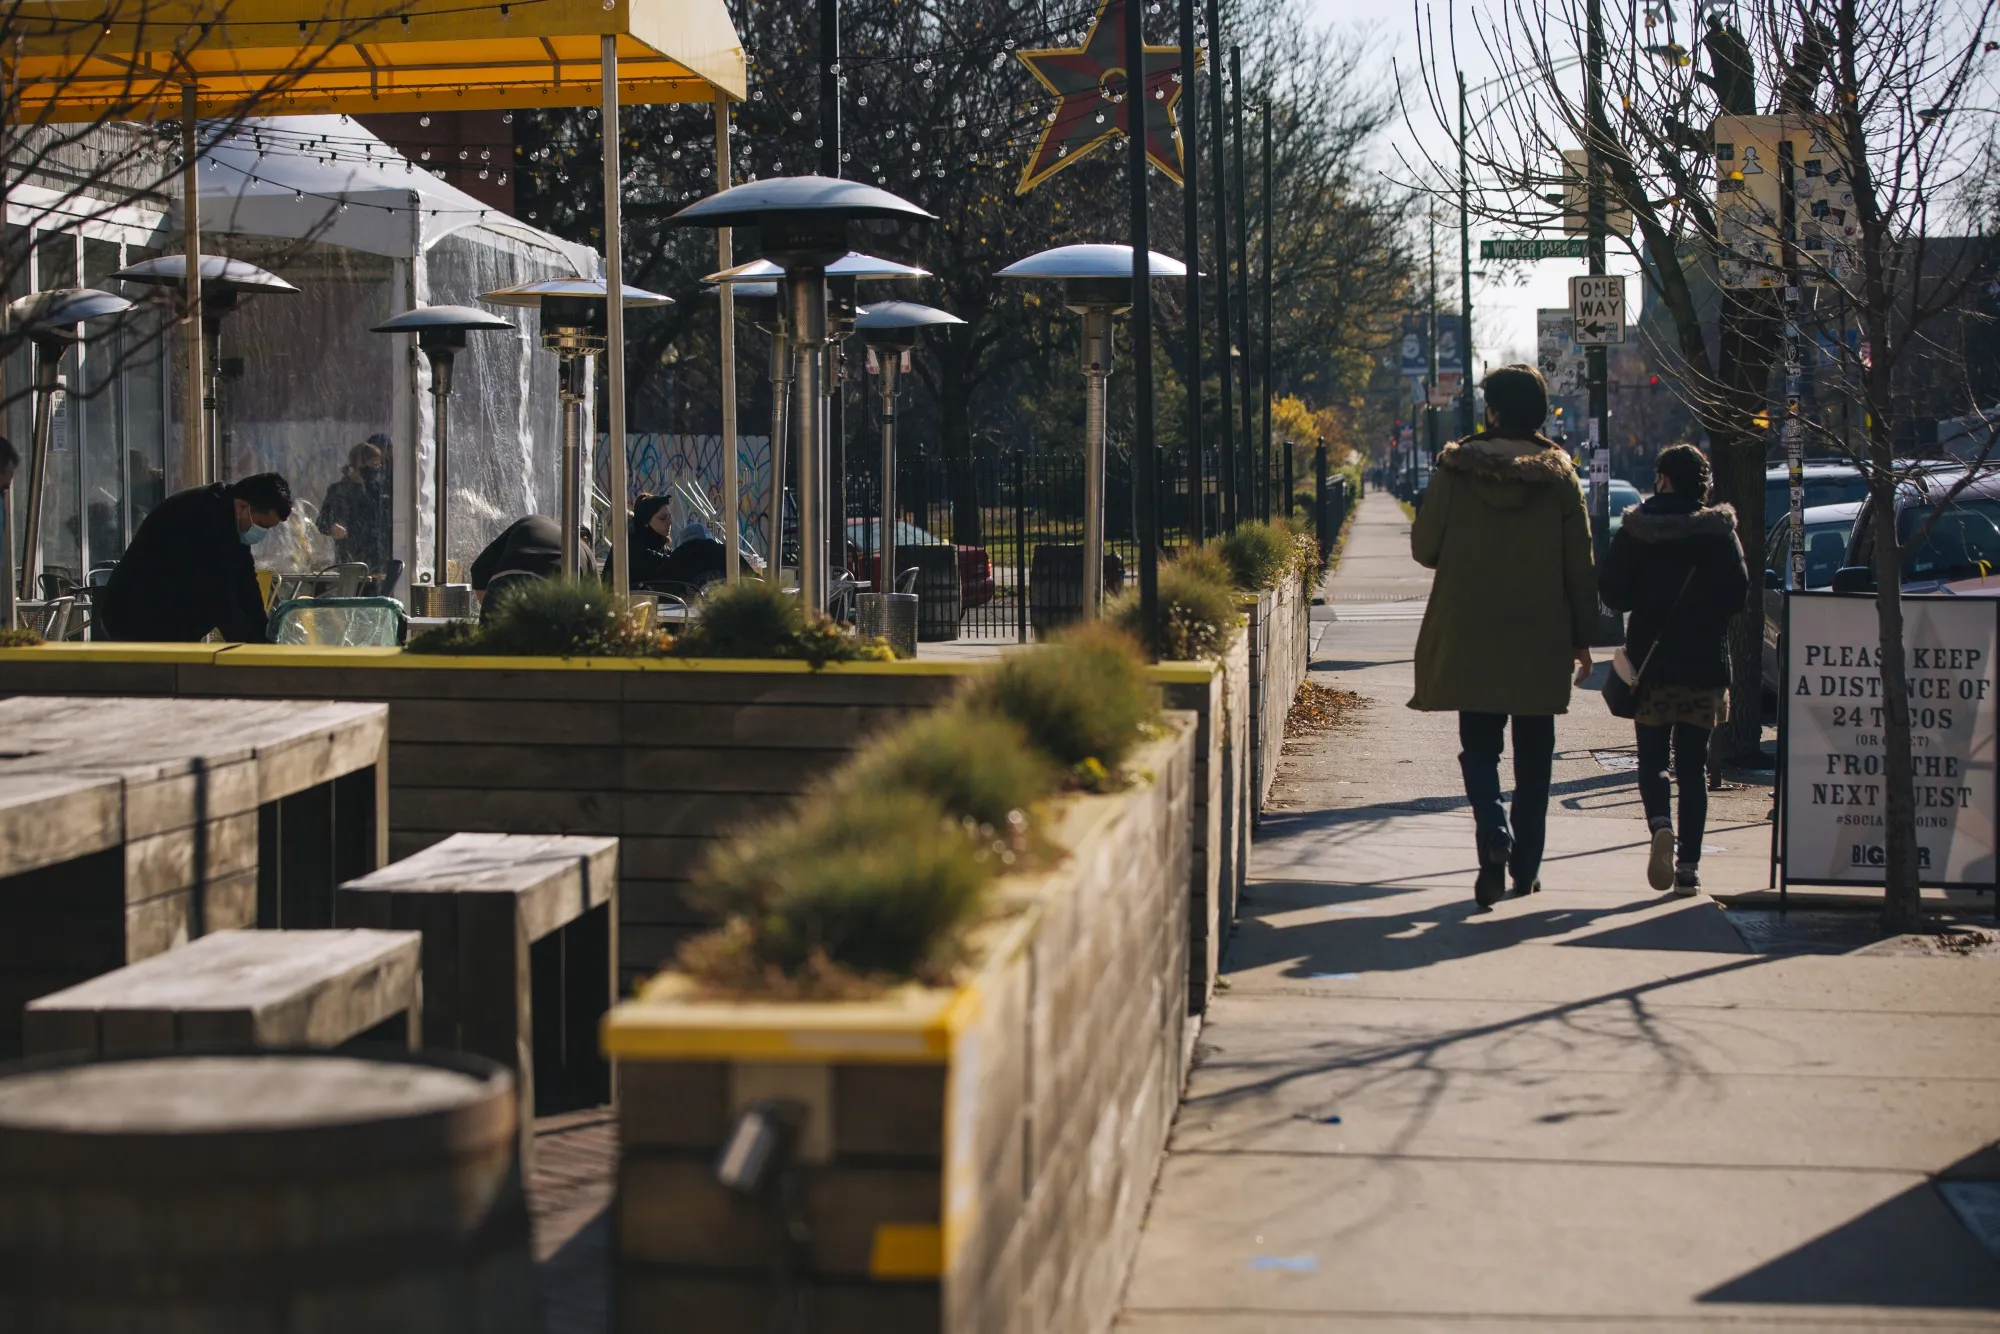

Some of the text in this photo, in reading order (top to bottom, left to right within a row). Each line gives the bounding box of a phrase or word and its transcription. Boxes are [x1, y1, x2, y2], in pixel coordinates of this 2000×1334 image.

[1493, 242, 1536, 257] WICKER
[1540, 242, 1570, 257] PARK
[1581, 282, 1618, 297] ONE
[1580, 300, 1619, 317] WAY
[1805, 645, 1981, 670] PLEAS KEEP
[1795, 675, 1990, 700] A DISTNCE OF
[1833, 706, 1952, 729] 24 TCOS
[1855, 734, 1878, 746] (OR
[1826, 754, 1958, 778] FRO THE
[1812, 784, 1879, 805] NEXT
